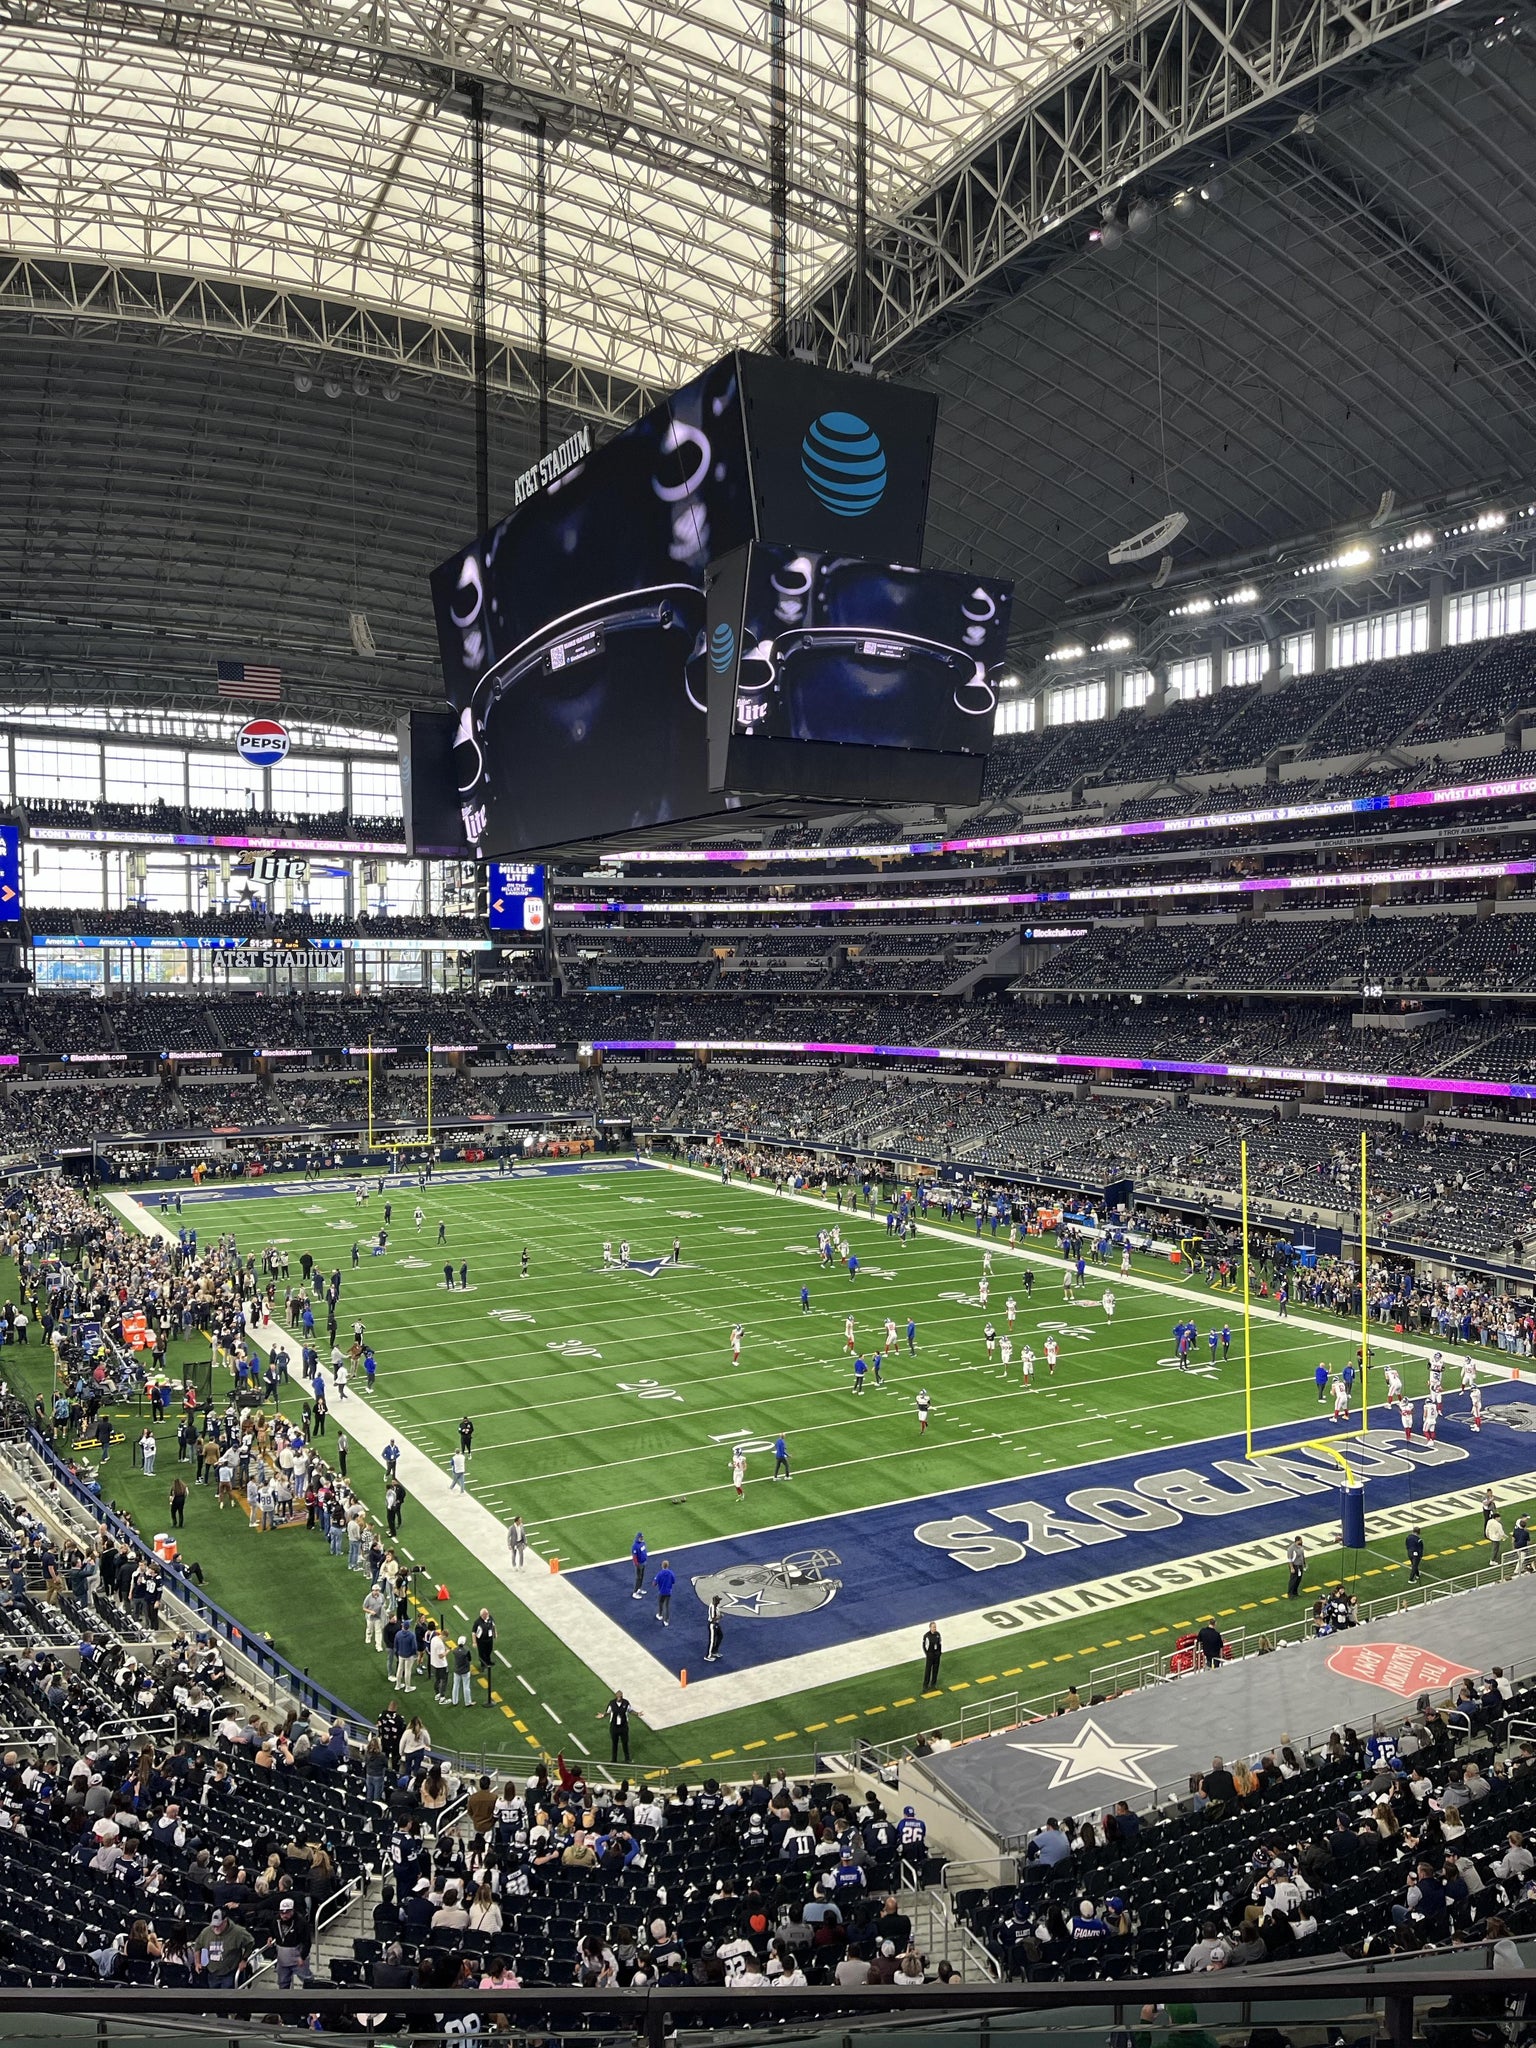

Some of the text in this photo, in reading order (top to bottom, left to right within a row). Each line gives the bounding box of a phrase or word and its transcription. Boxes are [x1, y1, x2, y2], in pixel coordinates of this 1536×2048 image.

[515, 425, 591, 506] AT&T STADIUM
[240, 736, 286, 750] PEPSI
[1434, 788, 1465, 803] INVEST
[1467, 787, 1488, 799] LIKE
[1490, 783, 1517, 797] YOUR
[1164, 801, 1352, 830] INVEST LIKE YOUR ICONS WITH Blockchain.com
[249, 855, 308, 885] Lite
[499, 866, 535, 875] MILLER
[1291, 877, 1318, 887] INVEST
[1431, 865, 1505, 879] Blockchain.com
[45, 938, 76, 946] American
[99, 938, 128, 946] American
[151, 938, 179, 946] American
[1033, 928, 1088, 938] Blockchain.com
[249, 939, 272, 948] 51:25
[213, 951, 344, 968] AT&T STADIUM
[70, 1054, 127, 1062] Blockchain.com
[168, 1052, 222, 1060] Blockchain.com
[487, 1308, 532, 1322] 40
[546, 1339, 597, 1357] 30
[616, 1378, 676, 1399] 20
[707, 1428, 776, 1454] 10
[913, 1429, 1469, 1572] COWBOYS
[983, 1533, 1338, 1630] THANKSGIVING
[1352, 1647, 1385, 1679] ARMY
[1381, 1646, 1422, 1692] SALVATION
[1418, 1661, 1447, 1685] THE
[1378, 1744, 1395, 1761] 12
[877, 1828, 888, 1845] 4
[902, 1826, 923, 1844] 26
[796, 1836, 810, 1854] 11
[1073, 1927, 1101, 1939] GIANTS
